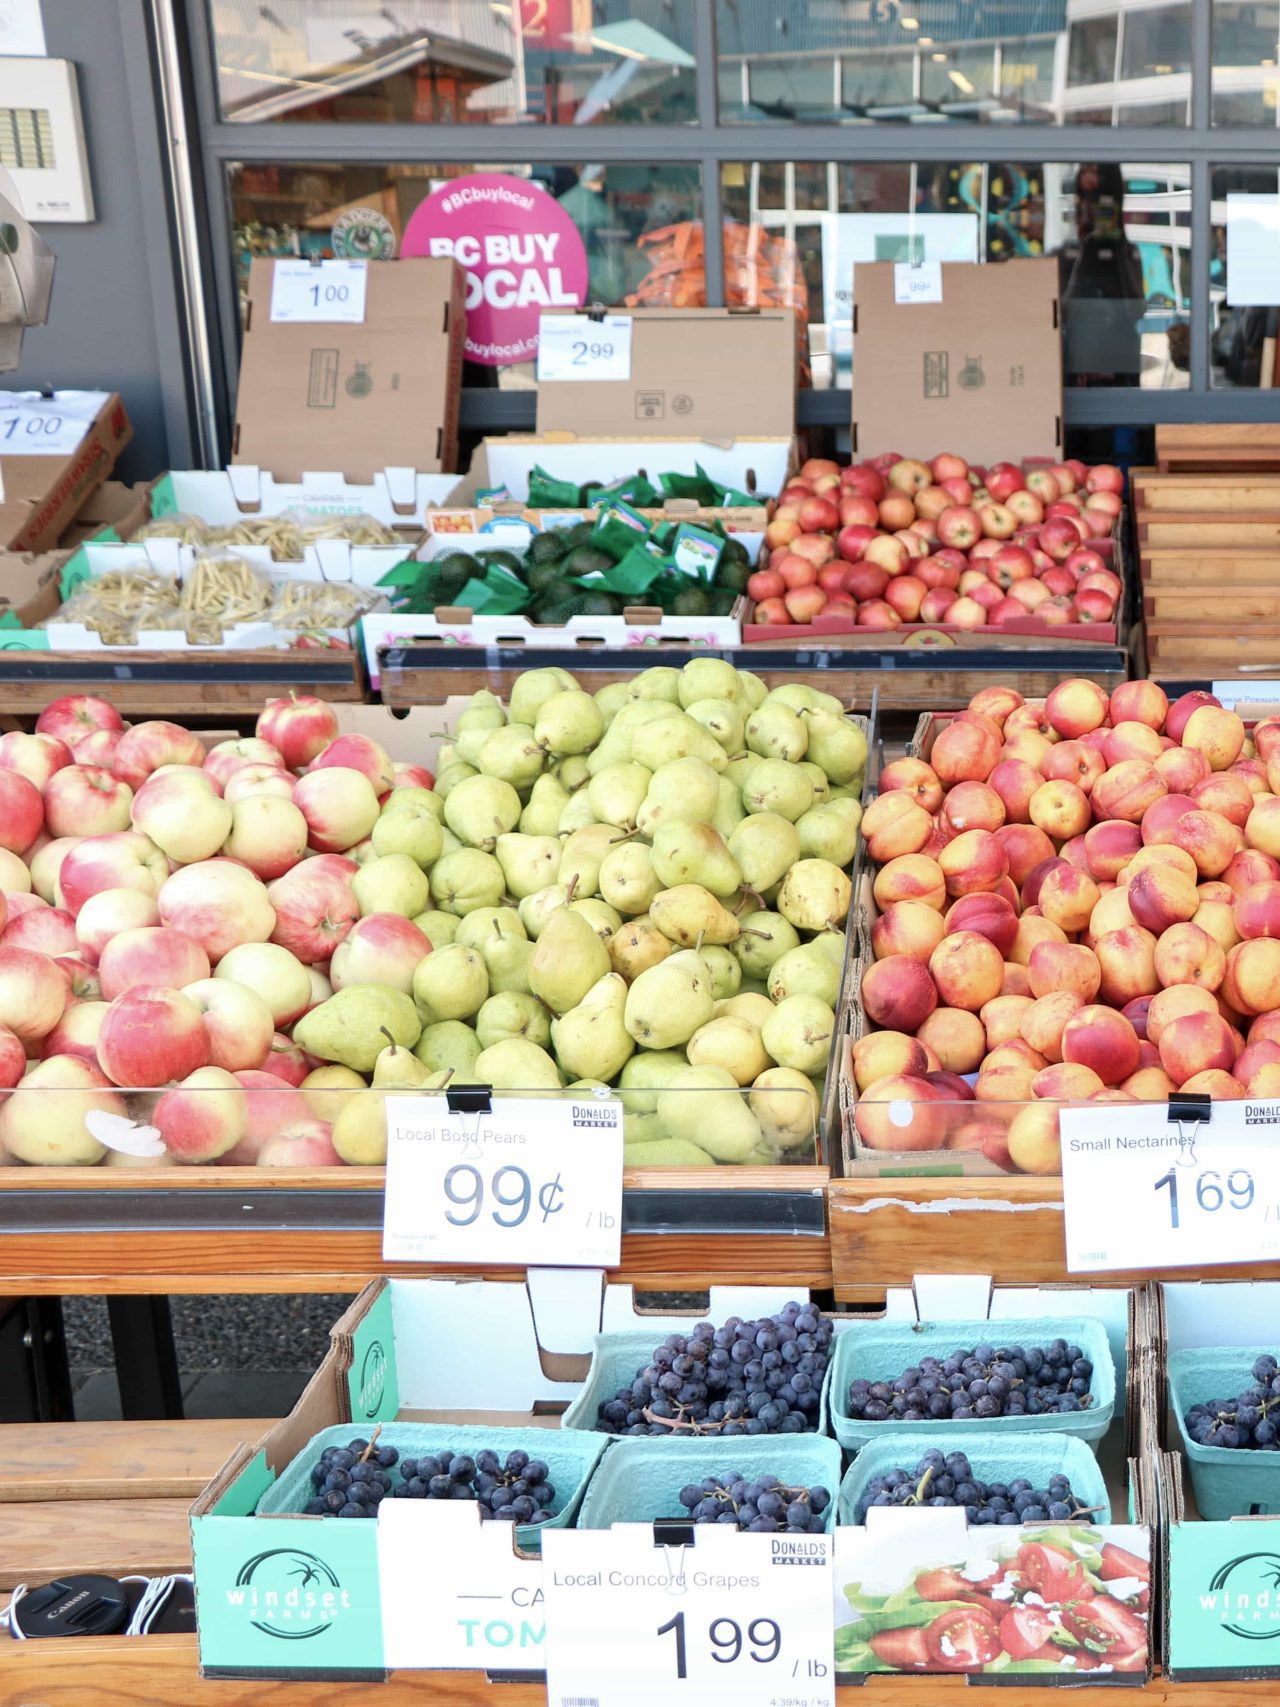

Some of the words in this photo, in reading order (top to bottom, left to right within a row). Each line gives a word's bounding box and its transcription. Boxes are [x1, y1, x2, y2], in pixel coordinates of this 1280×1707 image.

[441, 185, 534, 214] #BCbuylocal
[484, 233, 559, 264] BUY
[464, 268, 578, 309] OCAL
[396, 1127, 436, 1141] Local
[484, 1131, 527, 1144] Pears
[1070, 1138, 1111, 1152] Small
[1116, 1135, 1196, 1149] Nectarines
[773, 1557, 825, 1566] MARKET
[553, 1571, 602, 1587] Local
[608, 1571, 687, 1587] Concord
[693, 1571, 760, 1590] Grapes
[47, 1590, 90, 1619] Canon
[226, 1587, 351, 1609] windset
